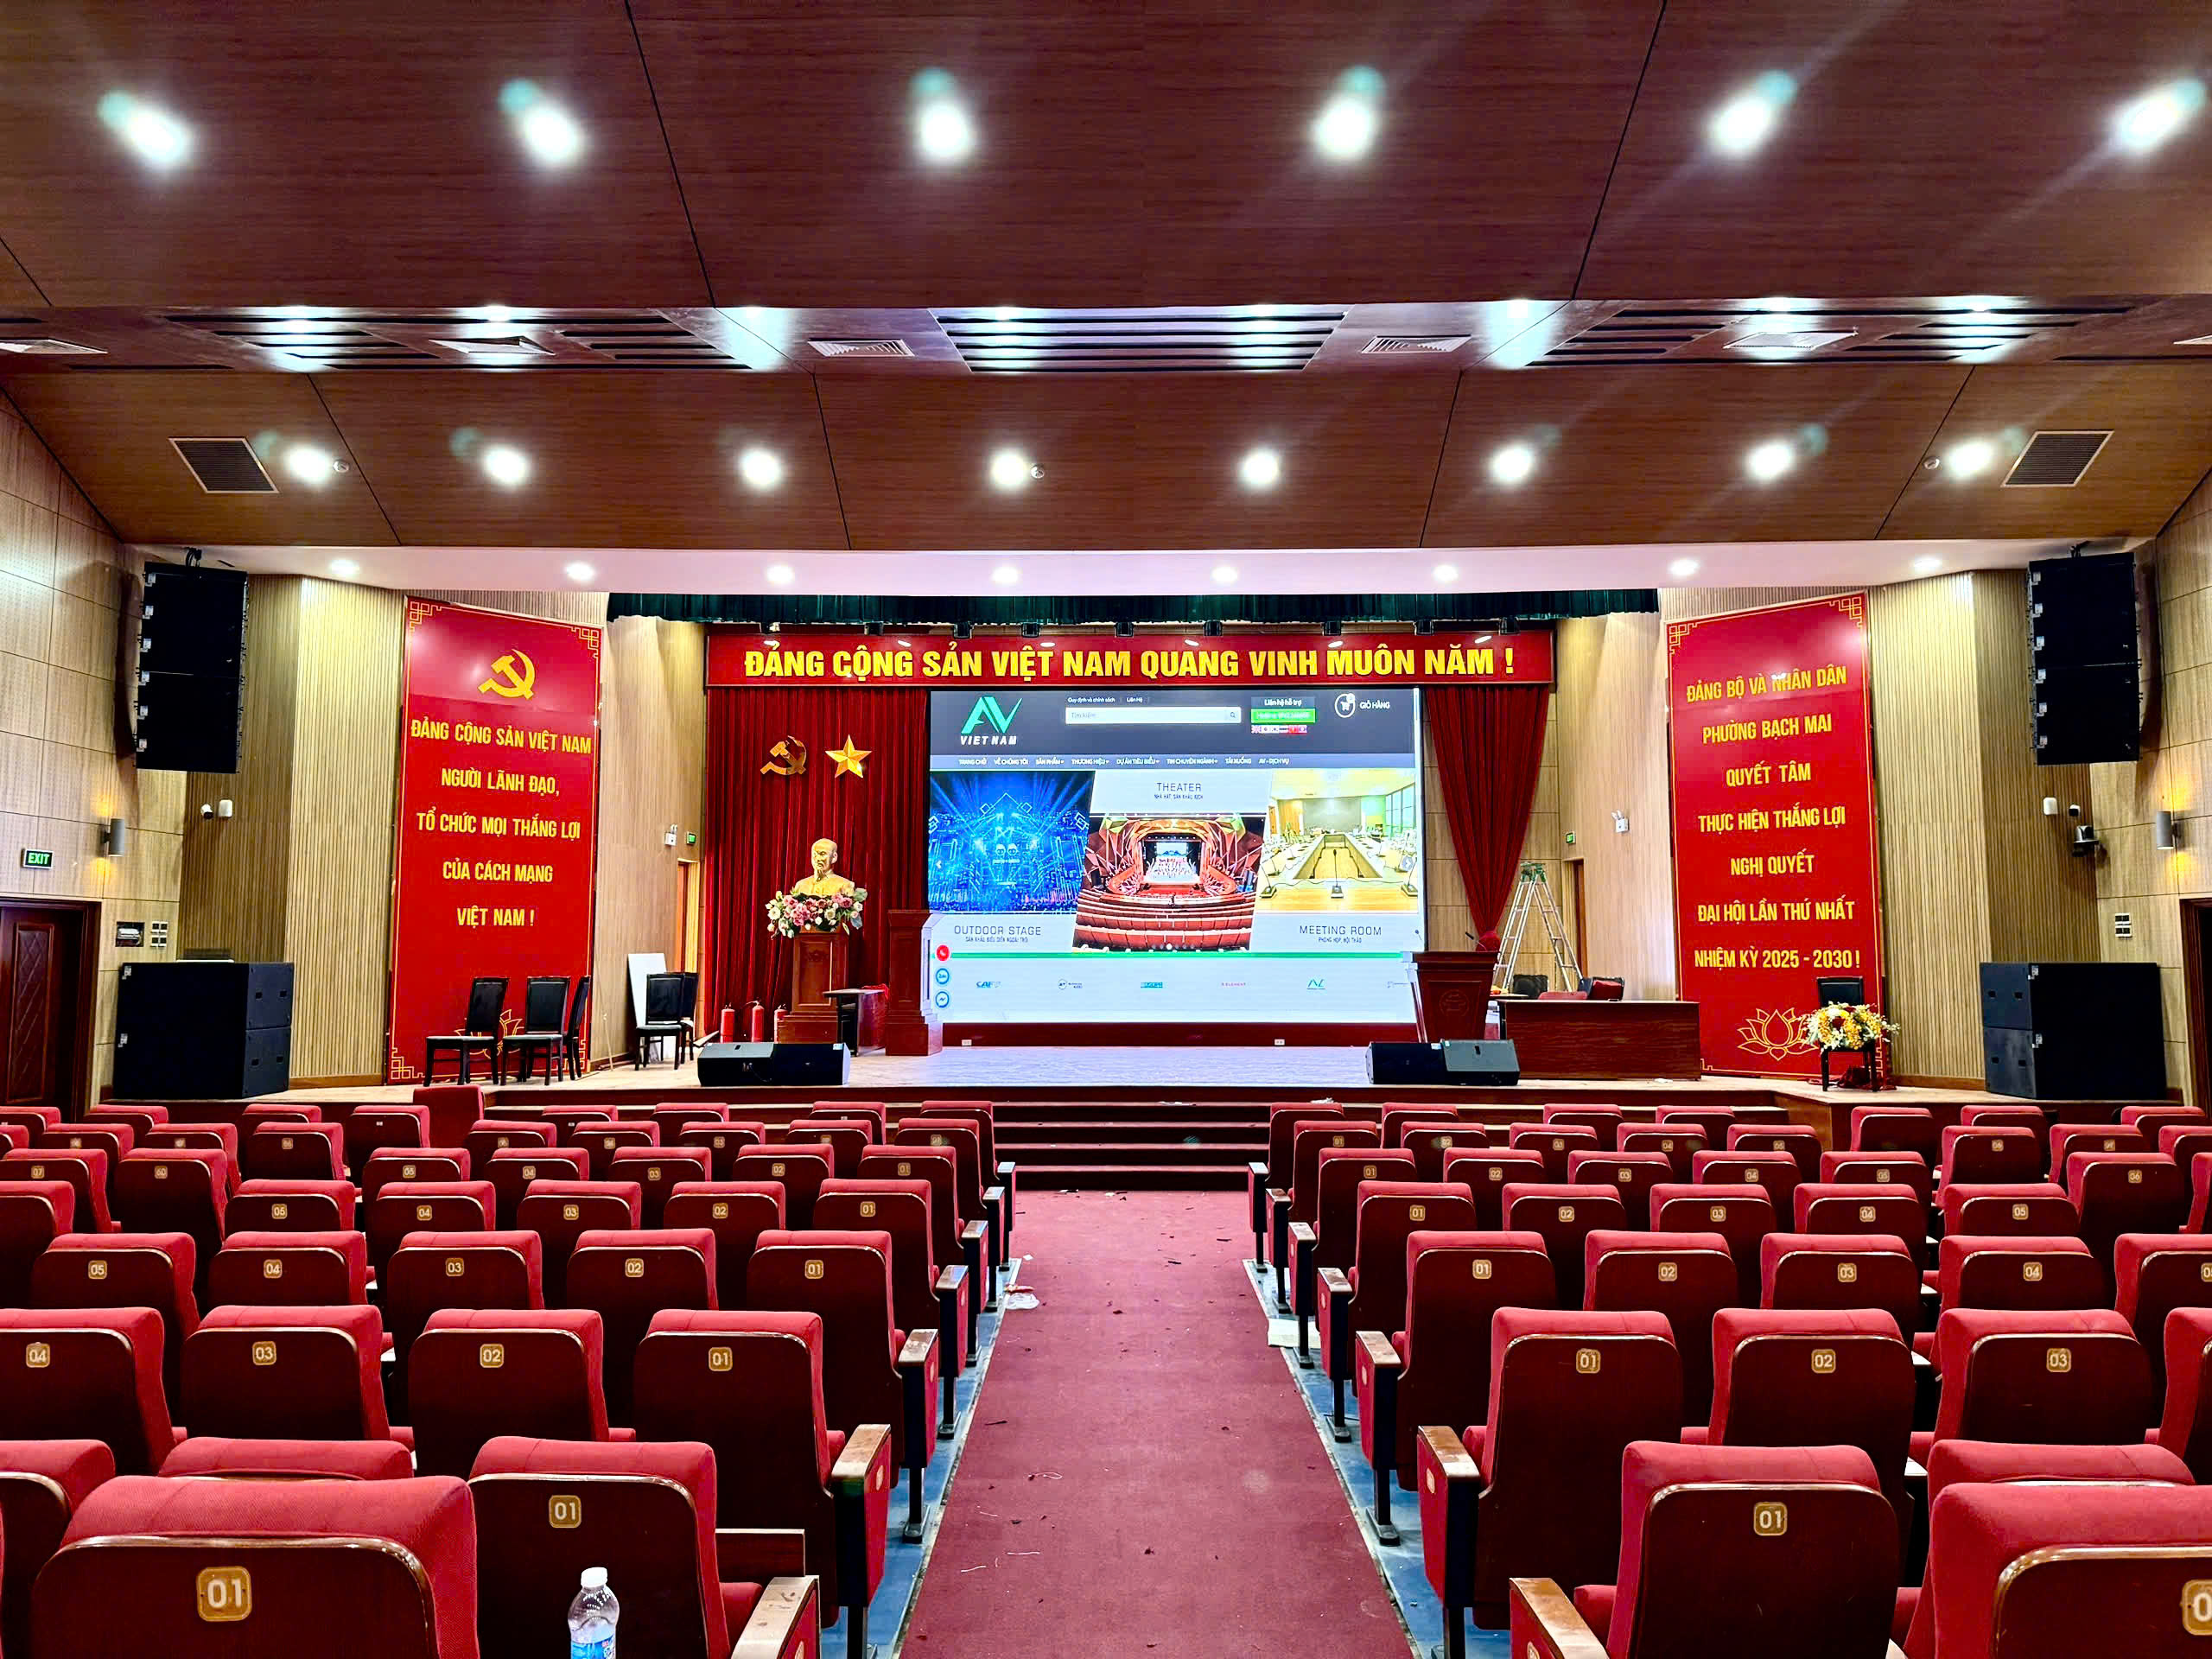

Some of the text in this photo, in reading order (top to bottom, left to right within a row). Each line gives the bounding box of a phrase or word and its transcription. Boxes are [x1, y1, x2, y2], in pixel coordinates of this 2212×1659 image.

[745, 641, 1514, 682] ĐẢNG CỘNG SẢN VIỆT NAM QUANG VINH MUÔN NĂM !
[1686, 663, 1847, 703] ĐẢNG BỘ VÀ NHÂN DÂN
[410, 716, 592, 754] ĐẢNG CỘNG SẢN VIỆT NAM
[1702, 714, 1832, 745] PHƯỜNG BẠCH MAI
[961, 736, 1017, 745] VIET NAM
[1726, 760, 1811, 787] QUYẾT TÂM
[442, 767, 560, 798] NGƯỜI LÃNH ĐẠO,
[1156, 782, 1202, 792] THEATER
[416, 806, 581, 840] TỔ CHỨC MỌI THẮNG LỢI
[1698, 802, 1846, 835] THỰC HIỆN THẮNG LỢI
[28, 852, 50, 865] EXIT
[1730, 849, 1815, 878] NGHỊ QUYẾT
[442, 857, 553, 885] CỦA CÁCH MẠNG
[1697, 893, 1855, 923] ĐẠI HỘI LẦN THỨ NHẤT
[456, 906, 535, 930] VIỆT NAM !
[954, 925, 1041, 936] OUTDOOR STAGE
[1300, 925, 1382, 935] MEETING ROOM
[1694, 947, 1736, 970] NHIỆM
[1739, 945, 1759, 968] KỲ
[1762, 950, 1799, 969] 2025
[1813, 950, 1853, 969] 2030
[274, 1206, 286, 1216] 05
[418, 1207, 430, 1217] 04
[565, 1207, 576, 1217] 03
[715, 1205, 726, 1215] 02
[862, 1205, 874, 1213] 01
[1412, 1208, 1423, 1217] 01
[1560, 1209, 1572, 1218] 02
[1712, 1209, 1723, 1218] 03
[1861, 1209, 1872, 1218] 04
[2014, 1207, 2025, 1217] 05
[91, 1263, 105, 1274] 05
[266, 1263, 280, 1274] 04
[448, 1262, 461, 1273] 03
[627, 1262, 642, 1274] 02
[808, 1263, 821, 1274] 01
[1476, 1263, 1489, 1274] 01
[1661, 1266, 1675, 1277] 02
[1840, 1267, 1854, 1278] 03
[2025, 1266, 2039, 1277] 04
[29, 1349, 47, 1363] 04
[256, 1347, 273, 1360] 03
[483, 1349, 501, 1363] 02
[713, 1353, 729, 1366] 01
[1580, 1353, 1597, 1367] 01
[2050, 1353, 2068, 1366] 03
[1815, 1354, 1833, 1367] 02
[554, 1502, 575, 1520] 01
[1759, 1510, 1782, 1529] 01
[207, 1578, 243, 1609] 01
[2193, 1592, 2212, 1622] 0
